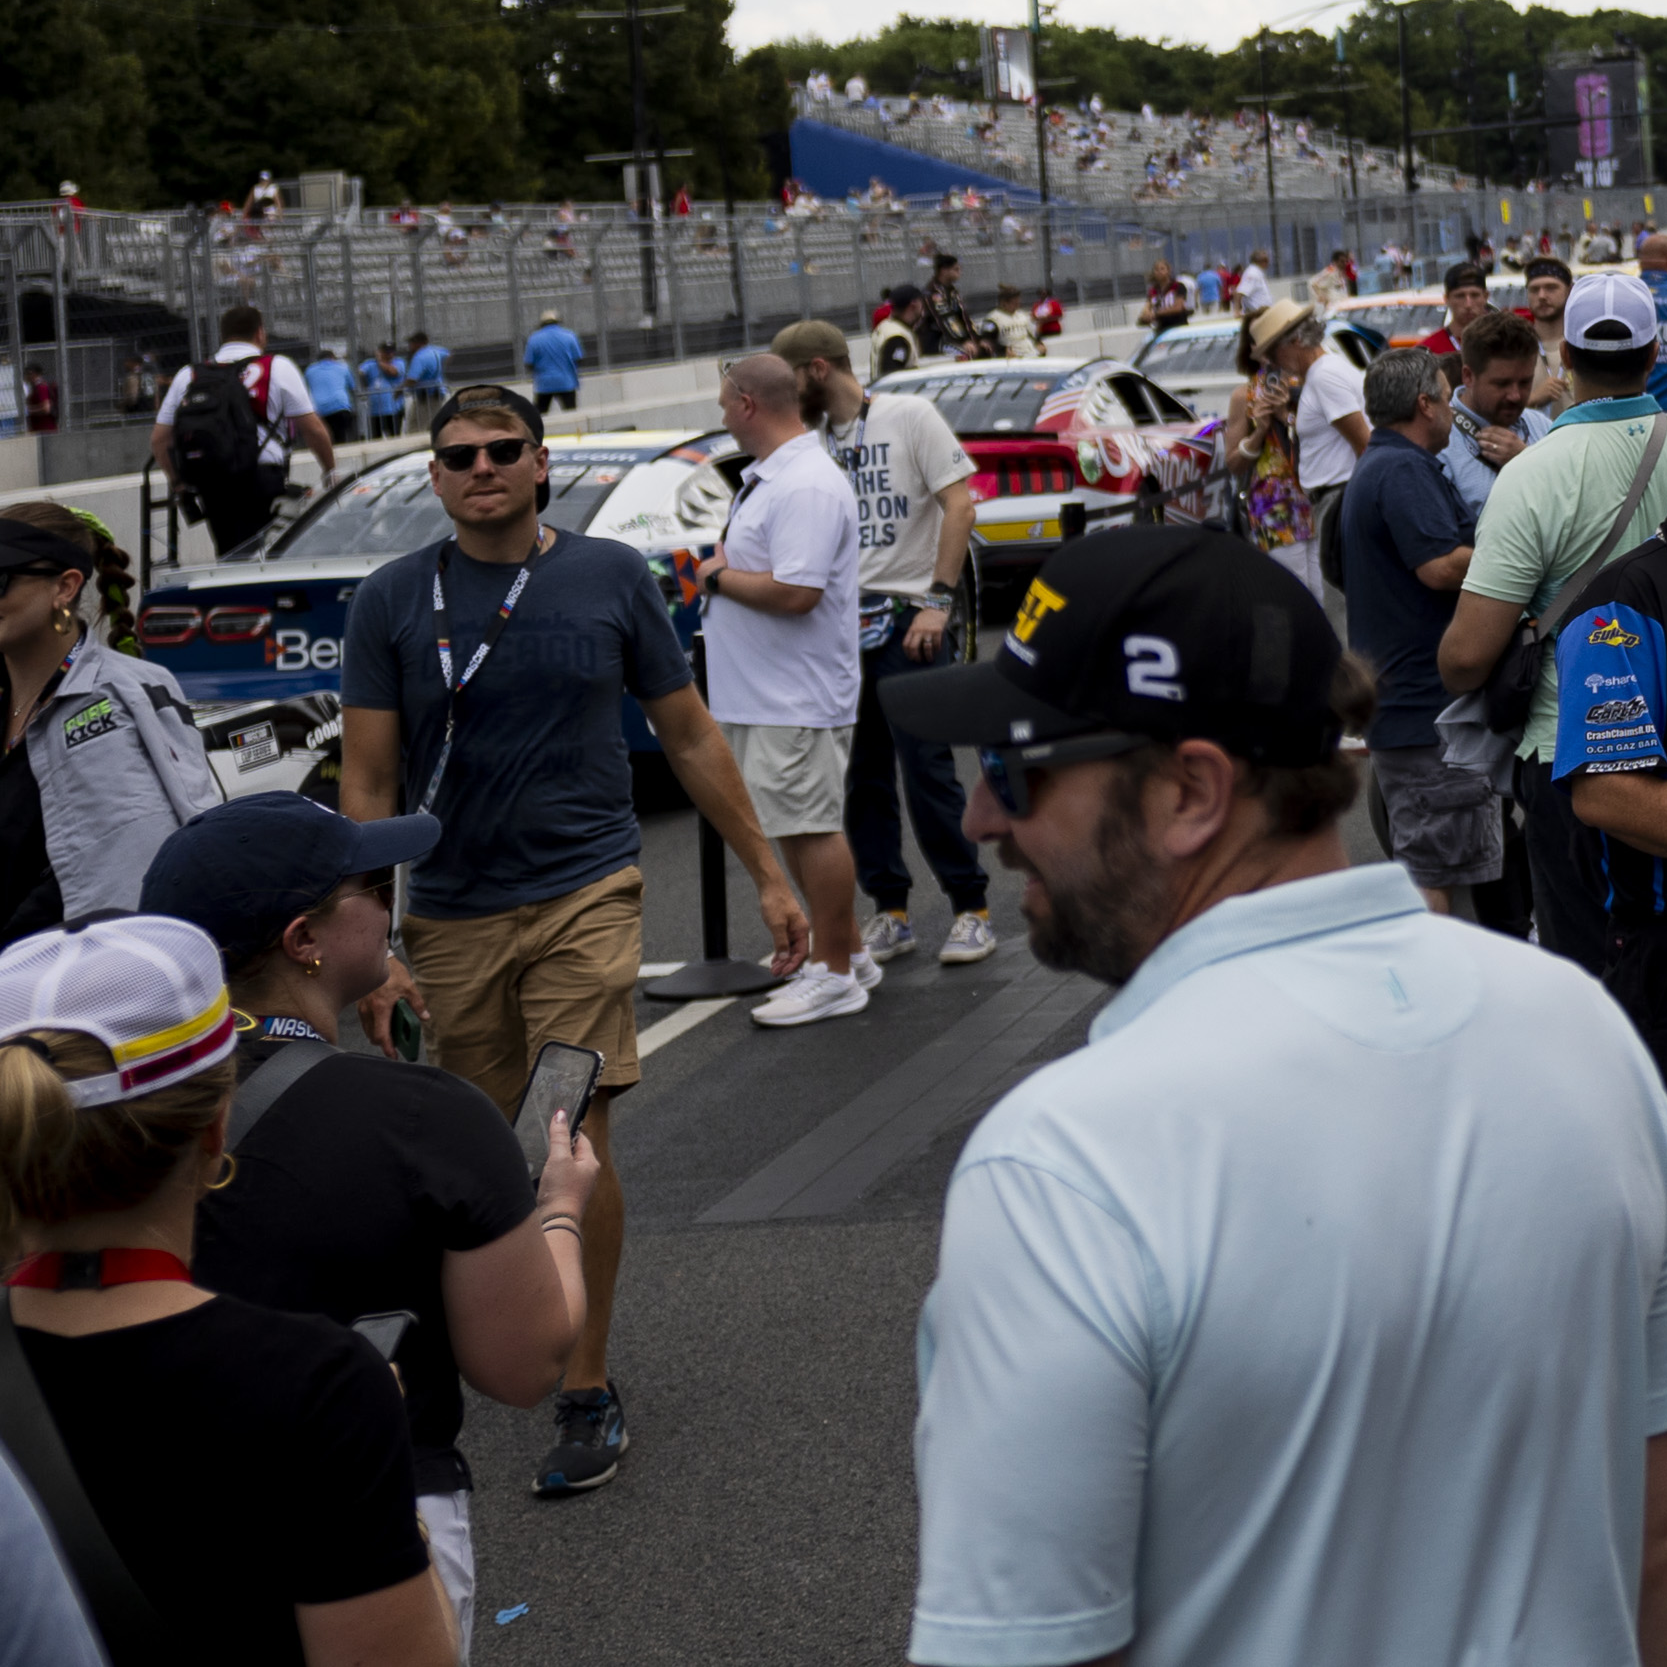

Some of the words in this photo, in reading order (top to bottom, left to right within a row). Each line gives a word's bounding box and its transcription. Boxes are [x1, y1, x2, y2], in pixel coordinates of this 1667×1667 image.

[876, 495, 909, 520] ON
[503, 566, 531, 608] NASCAR
[276, 629, 343, 672] Be
[461, 642, 490, 682] NASCAR
[1123, 634, 1188, 703] 2
[1605, 673, 1638, 687] share
[66, 698, 113, 732] PURE
[66, 714, 116, 747] KICK
[1586, 744, 1615, 754] O.C.R
[1615, 742, 1636, 752] GAZ
[1637, 738, 1658, 749] BAR
[269, 1016, 327, 1041] NASC
